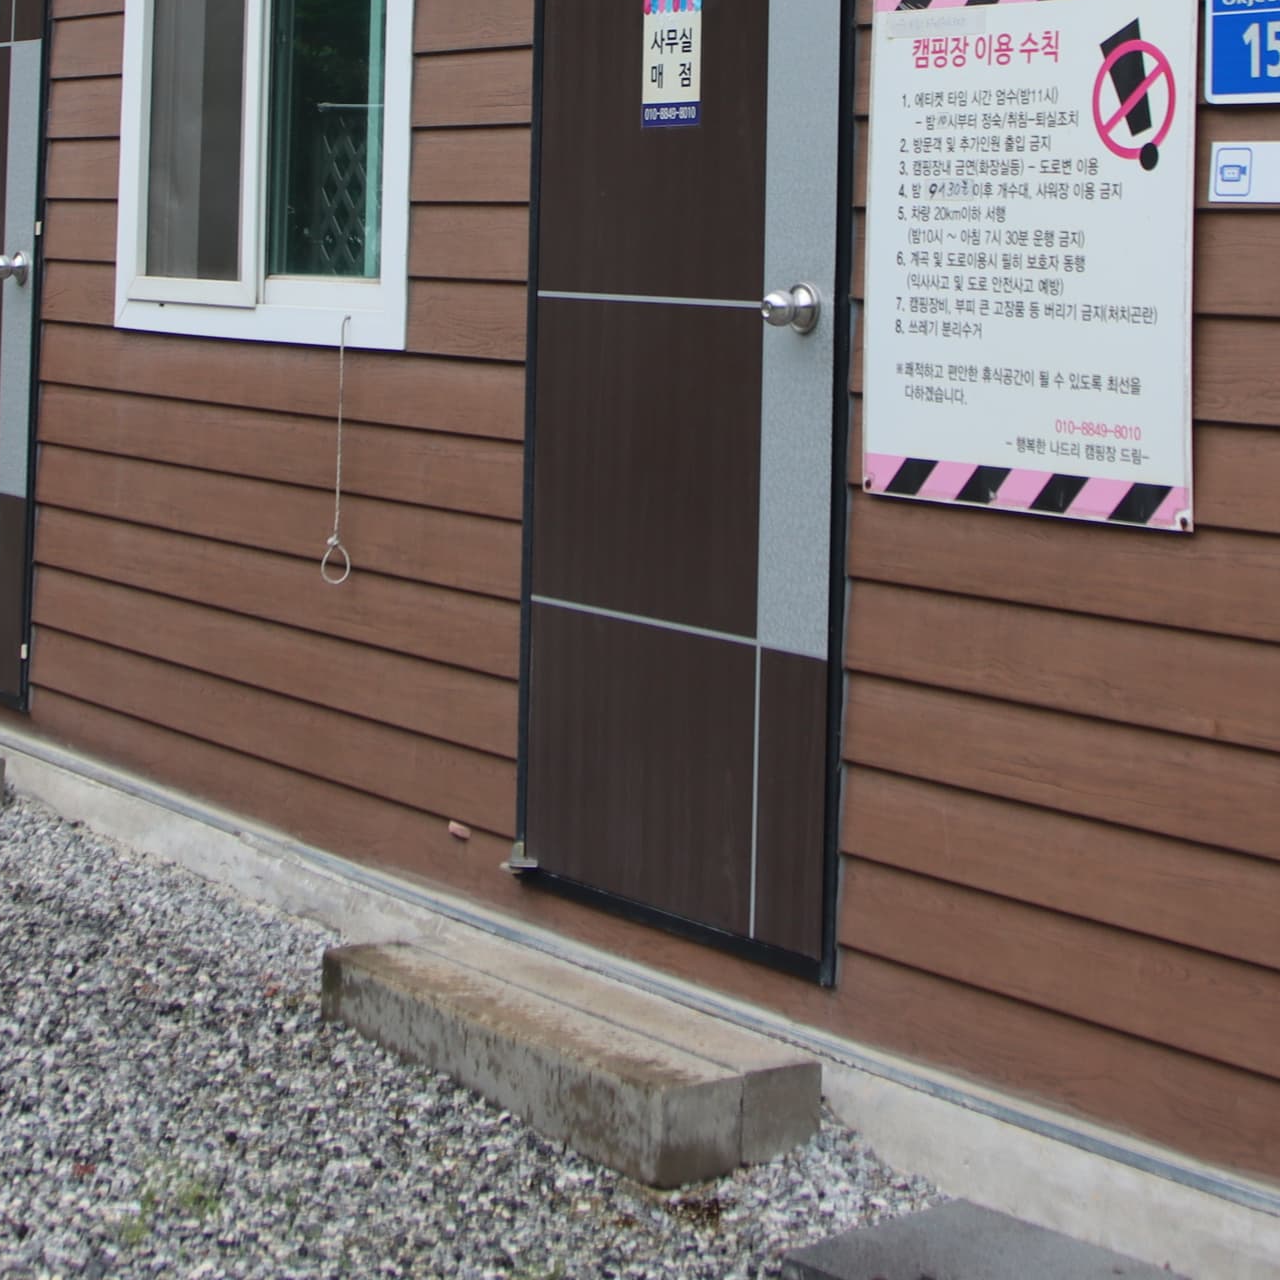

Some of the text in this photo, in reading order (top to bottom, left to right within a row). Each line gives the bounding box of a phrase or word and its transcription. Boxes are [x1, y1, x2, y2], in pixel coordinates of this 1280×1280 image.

[650, 27, 693, 55] 사무실
[912, 30, 1060, 69] 캠핑장 이용 수칙
[914, 91, 944, 108] 에티켓
[947, 90, 968, 107] 타임
[972, 89, 992, 106] 시간
[913, 136, 943, 154] 방문객
[946, 136, 956, 152] 및
[959, 135, 1001, 152] 추가인원
[1004, 135, 1026, 152] 출입
[1030, 135, 1052, 151] 금지
[912, 160, 951, 177] 캠핑장내
[954, 159, 1024, 177] 금연(화장실등)
[1039, 158, 1072, 176] 도로변
[1076, 158, 1099, 175] 이용
[912, 183, 921, 199] 밤
[997, 182, 1032, 200] 개수대,
[1074, 182, 1096, 199] 이용
[1099, 182, 1122, 199] 금지
[911, 206, 930, 222] 차량
[934, 205, 982, 222] 20km이하
[985, 205, 1006, 223] 서행
[907, 229, 943, 245] (밤10시
[960, 229, 981, 246] 아침
[984, 229, 1002, 246] 7시
[1005, 229, 1029, 247] 30분
[1033, 229, 1054, 248] 운행
[1058, 230, 1085, 248] 금지)
[910, 252, 929, 267] 계곡
[933, 252, 943, 268] 및
[946, 252, 998, 270] 도로이용시
[1001, 253, 1022, 271] 필히
[1026, 254, 1059, 271] 보호자
[1063, 254, 1085, 272] 동행
[907, 274, 1064, 296] (익사사고 및 도로 안전사고 예방)
[909, 297, 951, 315] 캠핑장비,
[955, 299, 976, 315] 부피
[979, 300, 990, 316] 큰
[993, 300, 1024, 318] 고장품
[1029, 302, 1040, 319] 등
[1044, 302, 1077, 321] 버리기
[1081, 303, 1157, 325] 금지(처치곤란)
[908, 320, 939, 337] 쓰레기
[942, 321, 982, 338] 분리수거
[948, 364, 978, 383] 편안한
[981, 368, 1035, 387] 휴식공간이
[1039, 370, 1049, 389] 될
[1053, 373, 1064, 390] 수
[1069, 372, 1103, 392] 있도록
[1107, 375, 1141, 396] 최선을
[905, 385, 968, 405] 다하겠습니다.
[1055, 419, 1141, 441] 010-8849-8010
[1016, 436, 1046, 455] 행복한
[1049, 439, 1081, 458] 나드리
[1085, 443, 1116, 462] 캠핑장
